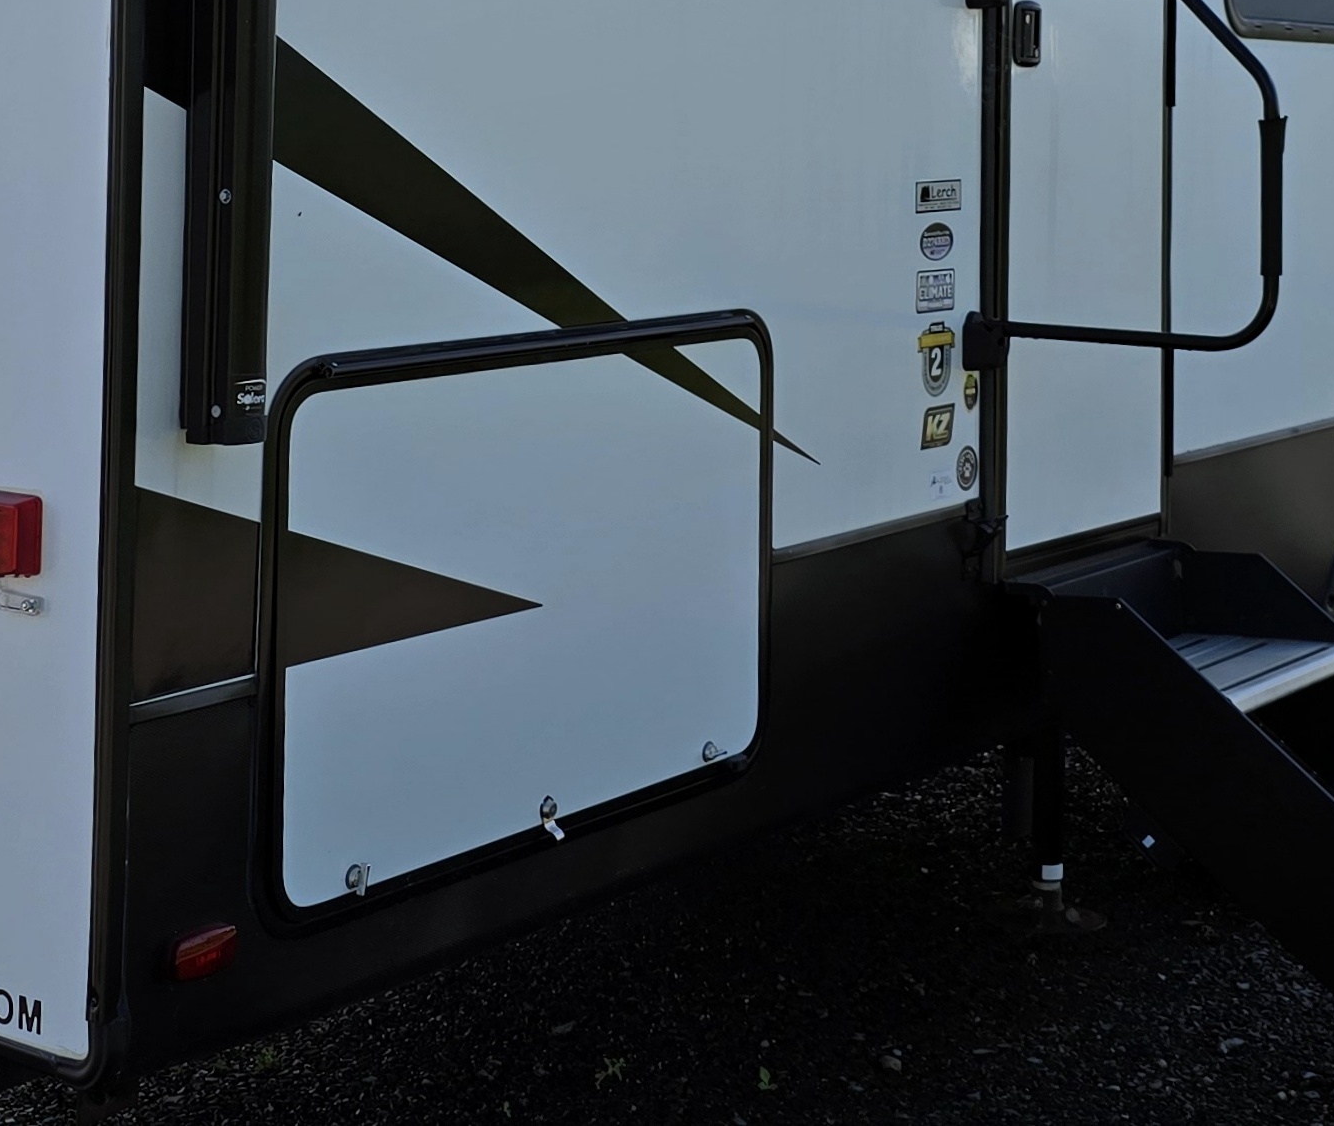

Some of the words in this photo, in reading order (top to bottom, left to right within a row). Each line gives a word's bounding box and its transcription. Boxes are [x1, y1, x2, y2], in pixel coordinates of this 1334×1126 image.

[931, 184, 957, 199] Lerch
[919, 285, 952, 300] CLIMATE
[930, 347, 942, 377] 2
[925, 412, 951, 442] KZ
